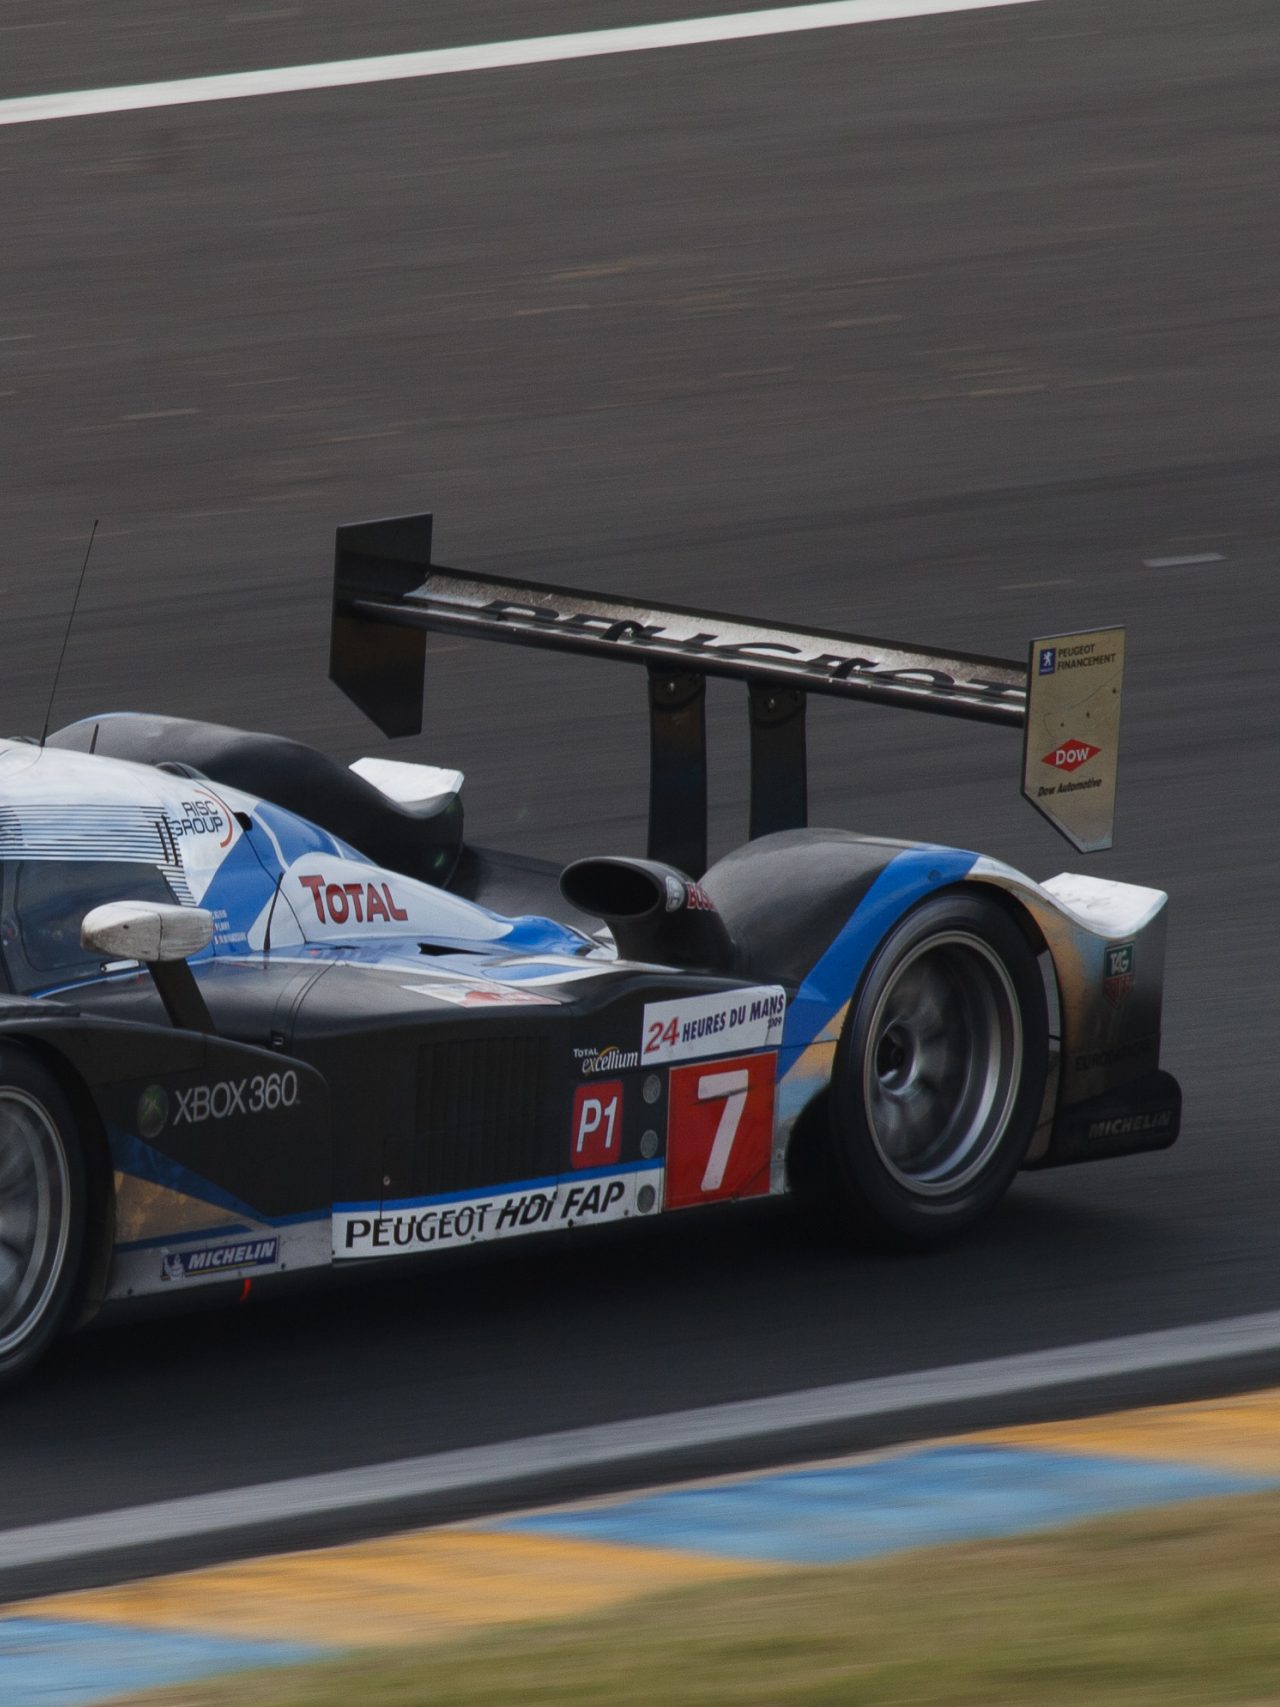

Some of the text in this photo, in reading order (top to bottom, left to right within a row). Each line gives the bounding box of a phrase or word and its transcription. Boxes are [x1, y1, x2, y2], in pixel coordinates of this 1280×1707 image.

[1057, 653, 1117, 670] FINANCEMENT
[1058, 643, 1095, 658] PEUGEOT
[1055, 747, 1090, 765] DOW
[1037, 777, 1102, 797] Dow Automotive
[181, 800, 219, 817] RISC
[167, 816, 223, 836] GROUP
[299, 875, 408, 925] TOTAL
[1110, 949, 1129, 975] TAG
[644, 994, 785, 1054] 24 HEURES DU MANS
[573, 1047, 599, 1058] TOTAL
[581, 1049, 639, 1074] excellium
[173, 1070, 298, 1126] XBOX 360
[576, 1096, 618, 1153] P1
[697, 1068, 749, 1192] 7
[1089, 1110, 1172, 1138] MICHELIN
[345, 1203, 493, 1249] PEUGEOT
[559, 1181, 625, 1219] FAP
[188, 1241, 276, 1270] MICHELIN
